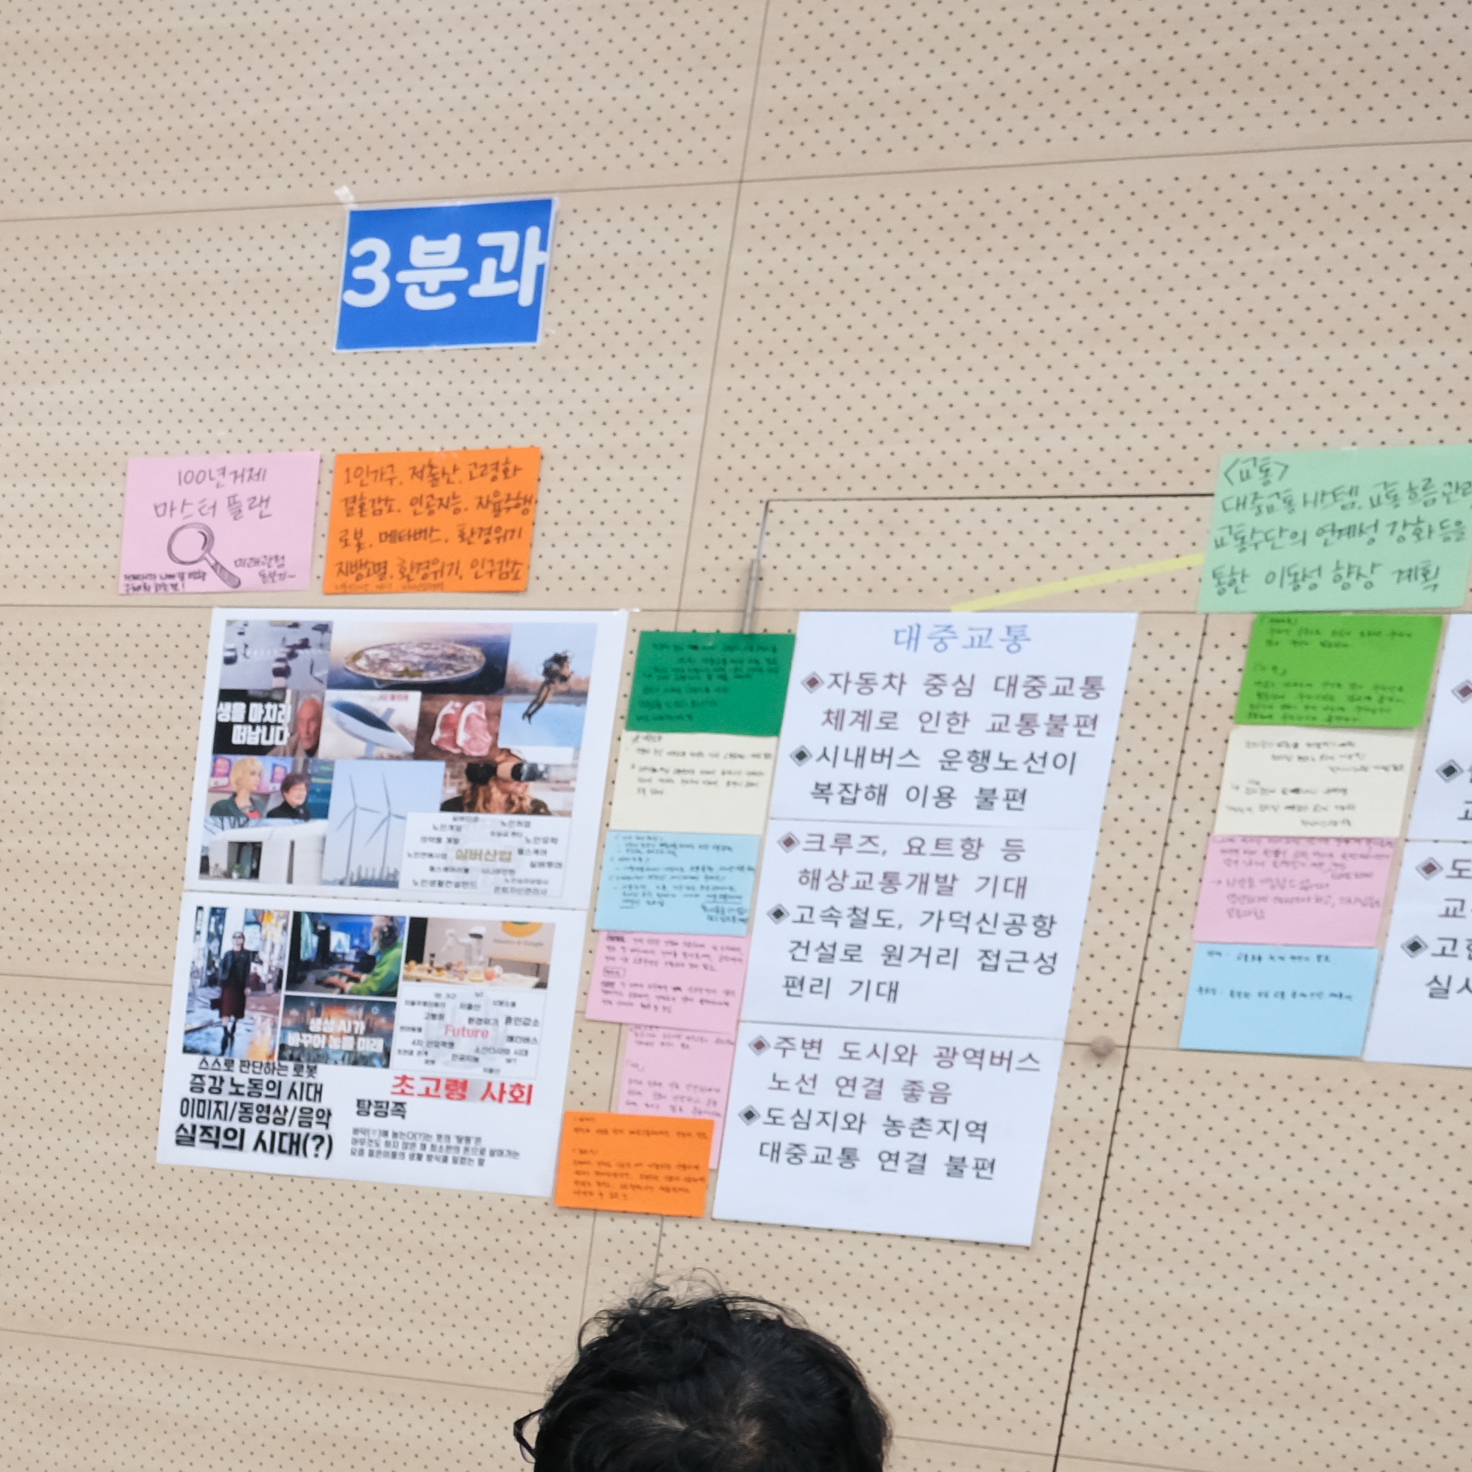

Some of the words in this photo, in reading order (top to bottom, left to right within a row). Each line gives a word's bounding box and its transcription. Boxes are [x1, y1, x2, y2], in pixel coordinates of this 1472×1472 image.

[342, 226, 548, 310] 3분과
[893, 624, 1032, 654] 대중교통
[827, 672, 907, 696] 자동차
[923, 673, 976, 698] 중심
[994, 675, 1106, 700] 대중교통
[822, 709, 899, 733] 체계로
[918, 711, 970, 735] 인한
[986, 713, 1100, 738] 교통불편
[815, 746, 921, 770] 시내버스
[938, 748, 1077, 776] 운행노선이
[811, 782, 889, 806] 복잡해
[905, 784, 957, 810] 이용
[974, 786, 1027, 812] 불편
[802, 832, 888, 856] 크루즈,
[903, 836, 985, 861] 요트항
[1001, 838, 1027, 862] 등
[798, 868, 959, 897] 해상교통개발
[975, 874, 1028, 899] 기대
[791, 904, 902, 931] 고속철도,
[920, 909, 1058, 939] 가덕신공항
[788, 939, 863, 964] 건설로
[881, 944, 960, 970] 원거리
[977, 948, 1058, 976] 접근성
[783, 975, 831, 1000] 편리
[849, 979, 900, 1004] 기대
[198, 1057, 234, 1072] 스스로
[239, 1062, 289, 1076] 판단하는
[293, 1064, 317, 1078] 로봇
[773, 1036, 823, 1060] 주변
[838, 1040, 918, 1067] 도시와
[934, 1044, 1042, 1073] 광역버스
[190, 1073, 225, 1094] 증강
[229, 1077, 282, 1099] 노동의
[288, 1081, 324, 1102] 시대
[391, 1075, 469, 1101] 초고령
[481, 1081, 533, 1105] 사회
[768, 1072, 817, 1096] 노선
[835, 1076, 885, 1101] 연결
[901, 1079, 953, 1105] 좋음
[180, 1098, 332, 1130] 이미지/동영상/음악
[763, 1107, 866, 1135] 도심지와
[882, 1114, 988, 1143] 농촌지역
[175, 1123, 245, 1151] 실직의
[253, 1129, 333, 1160] 시대(?)
[759, 1141, 860, 1169] 대중교통
[878, 1149, 928, 1175] 연결
[945, 1154, 997, 1181] 불편
